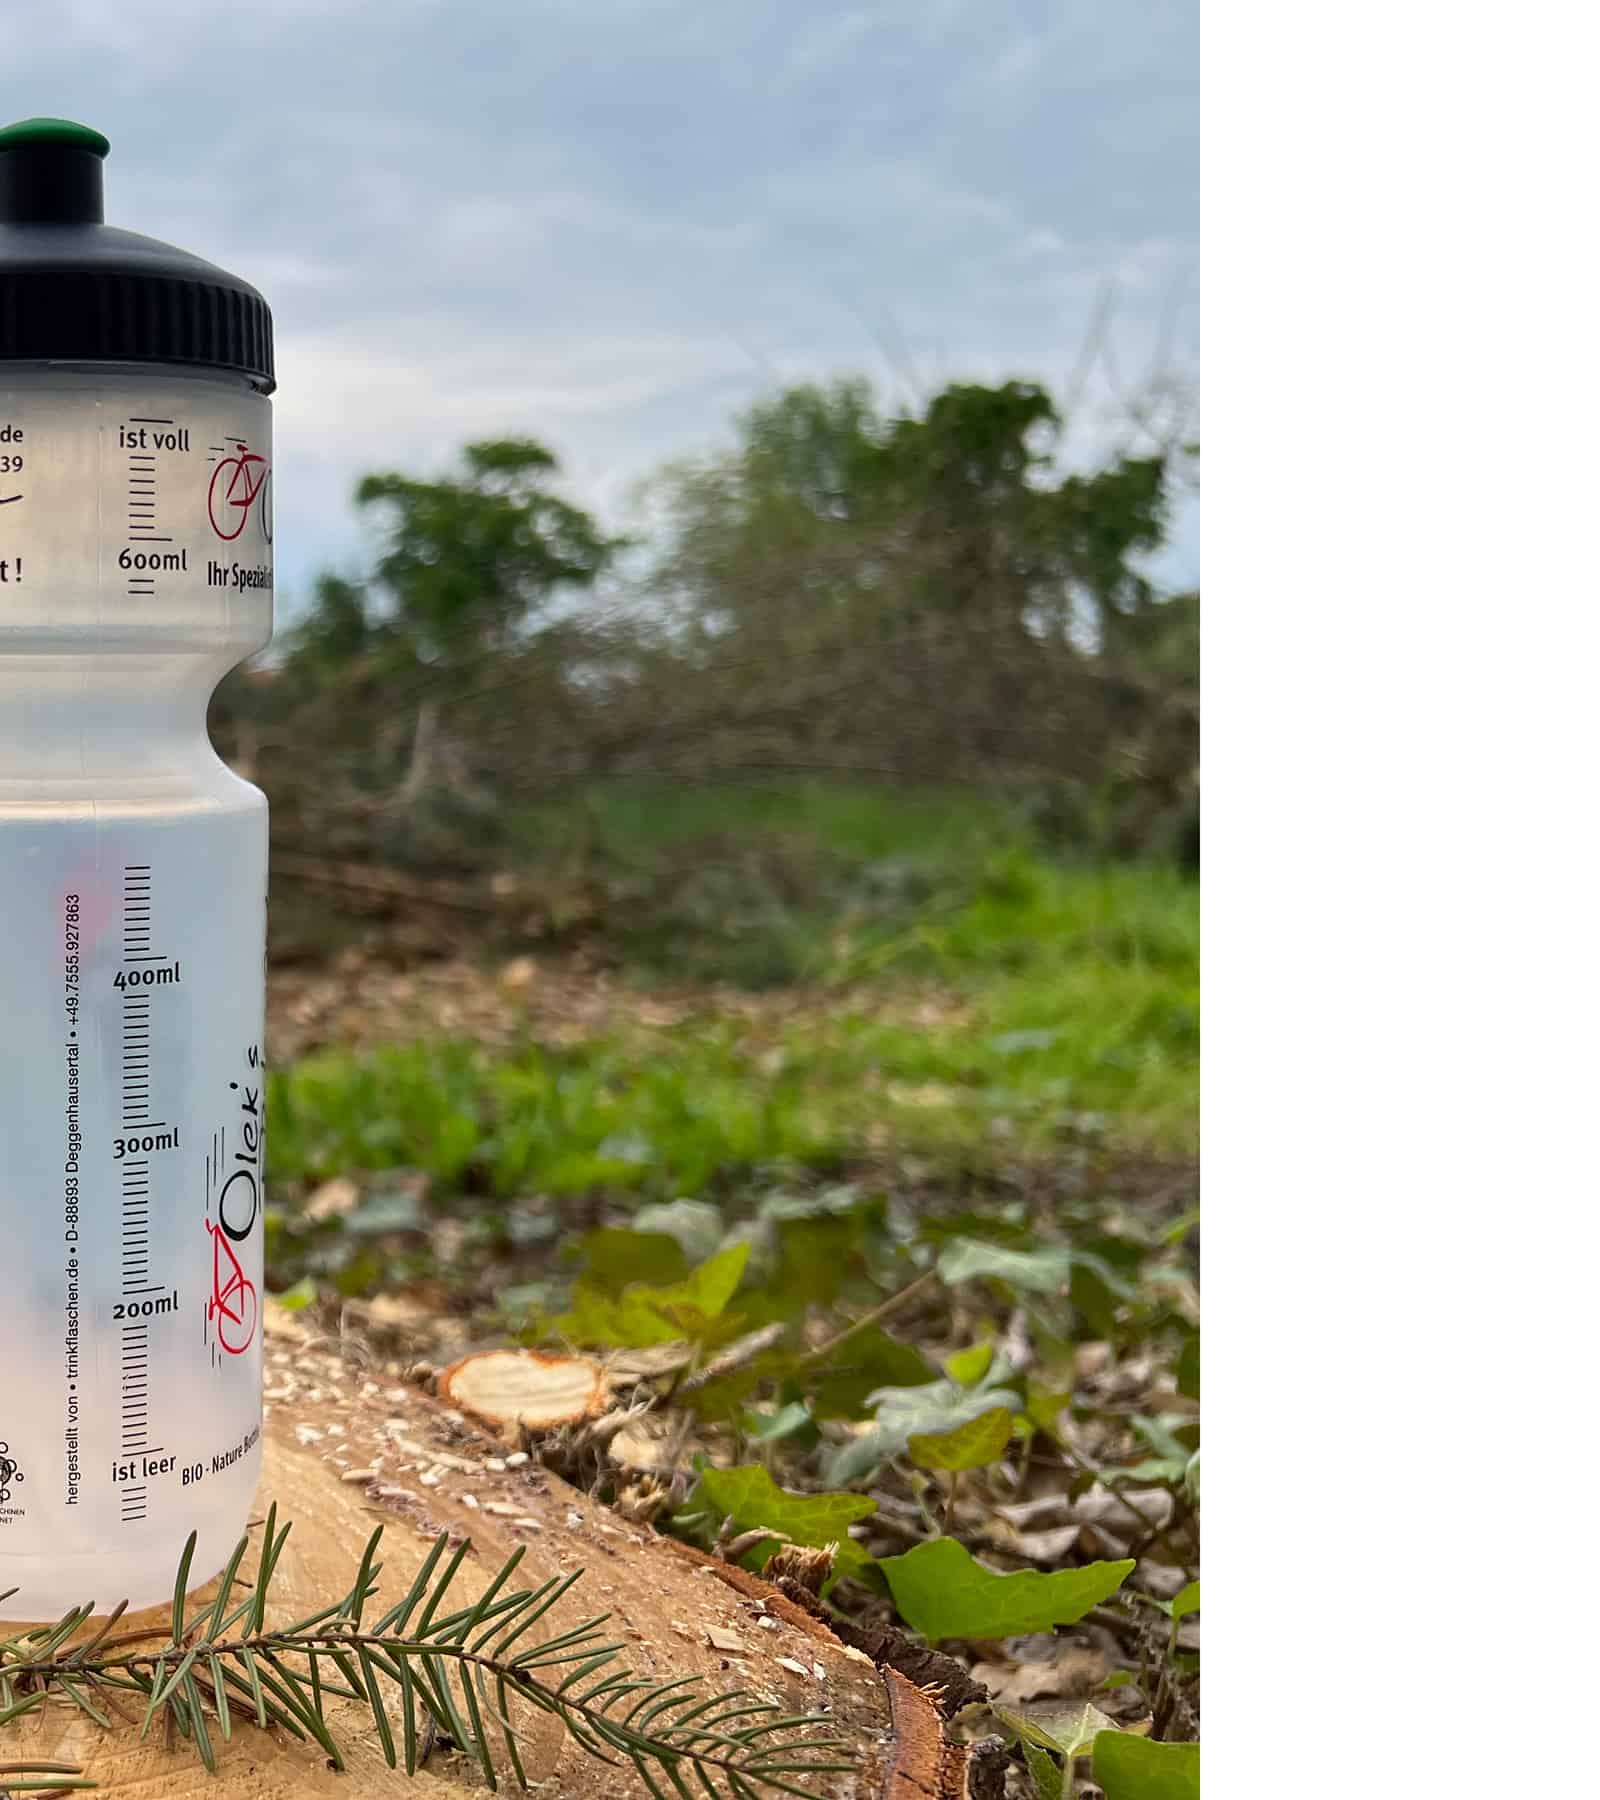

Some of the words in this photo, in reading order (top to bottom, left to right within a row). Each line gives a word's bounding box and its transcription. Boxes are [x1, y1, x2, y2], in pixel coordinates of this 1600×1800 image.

[118, 425, 148, 449] ist
[153, 429, 190, 452] voll
[118, 548, 187, 571] 600ml
[207, 561, 229, 586] Ihr
[65, 894, 80, 1026] +49.7555.927863
[113, 962, 180, 991] 400ml
[65, 1043, 82, 1173] Deggenhausertal
[113, 1128, 179, 1159] 300ml
[65, 1177, 79, 1241] D-88693
[65, 1258, 79, 1379] trinkflaschen.de
[113, 1291, 178, 1320] 200ml
[68, 1396, 79, 1424] von
[65, 1427, 82, 1505] hergestellt
[112, 1462, 137, 1482] ist
[142, 1456, 177, 1478] leer
[182, 1463, 203, 1486] BIO
[212, 1445, 243, 1474] Nature
